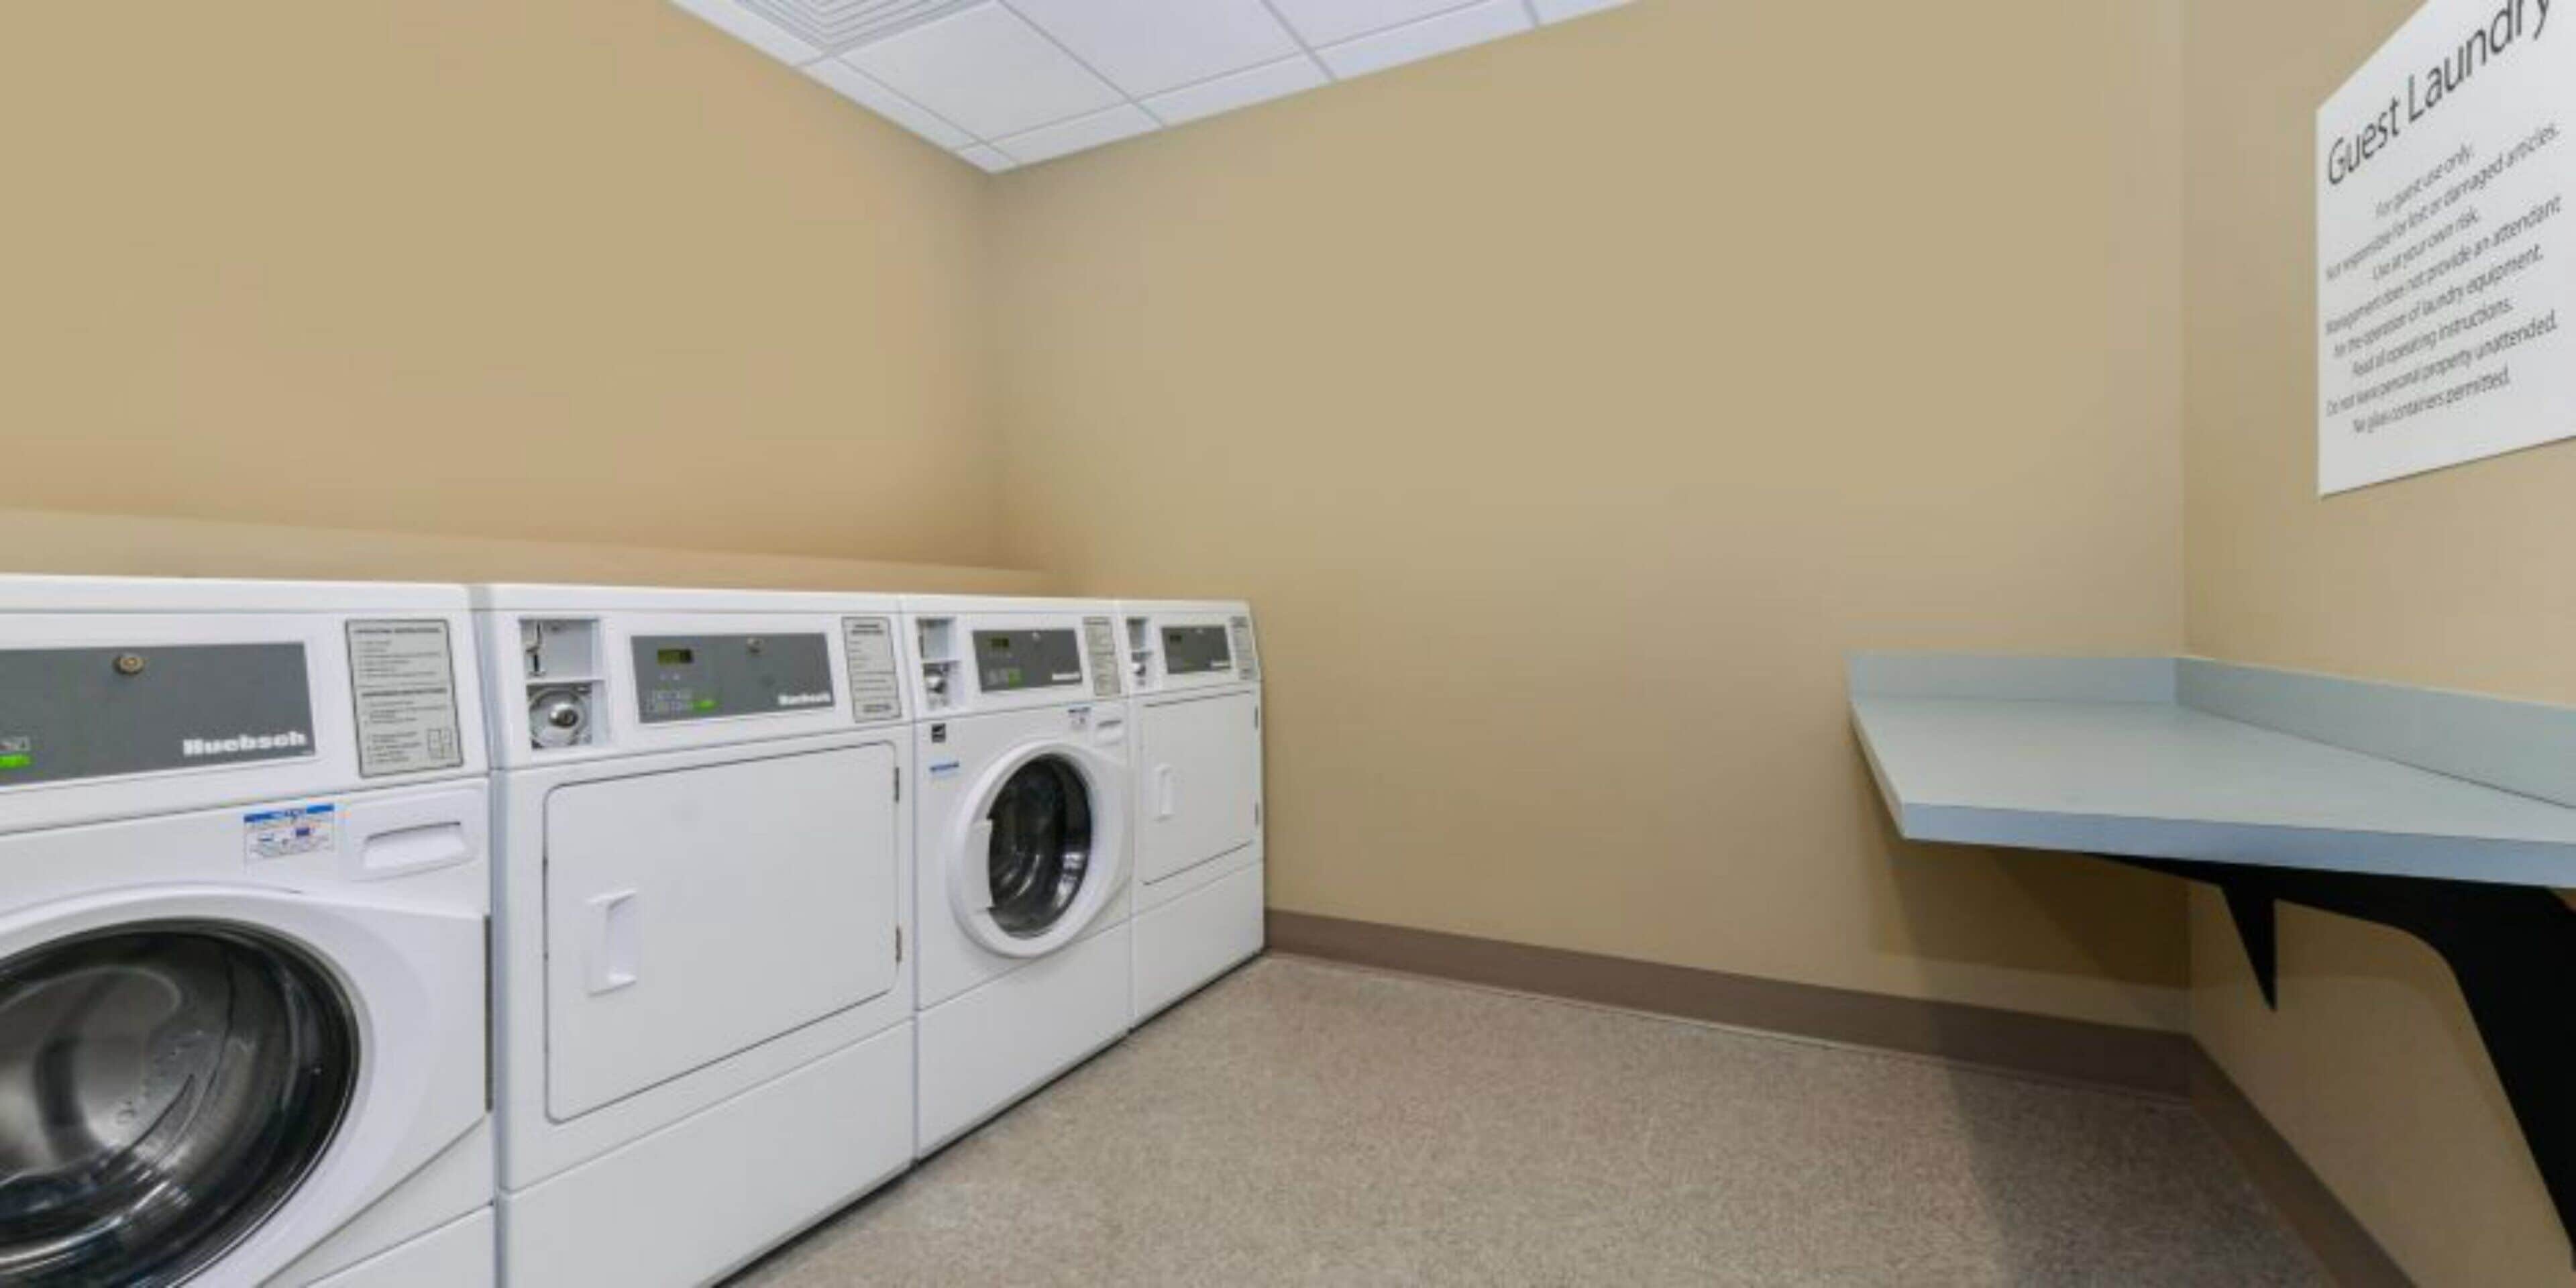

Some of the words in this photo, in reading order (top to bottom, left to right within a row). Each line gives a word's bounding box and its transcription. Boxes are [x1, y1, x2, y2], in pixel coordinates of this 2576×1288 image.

[2328, 97, 2400, 185] Guest
[2408, 0, 2549, 123] Laundry
[2467, 244, 2544, 294] equipment.
[2475, 309, 2557, 360] unattended.
[2445, 364, 2510, 408] permitted.
[182, 731, 307, 757] Huebsch
